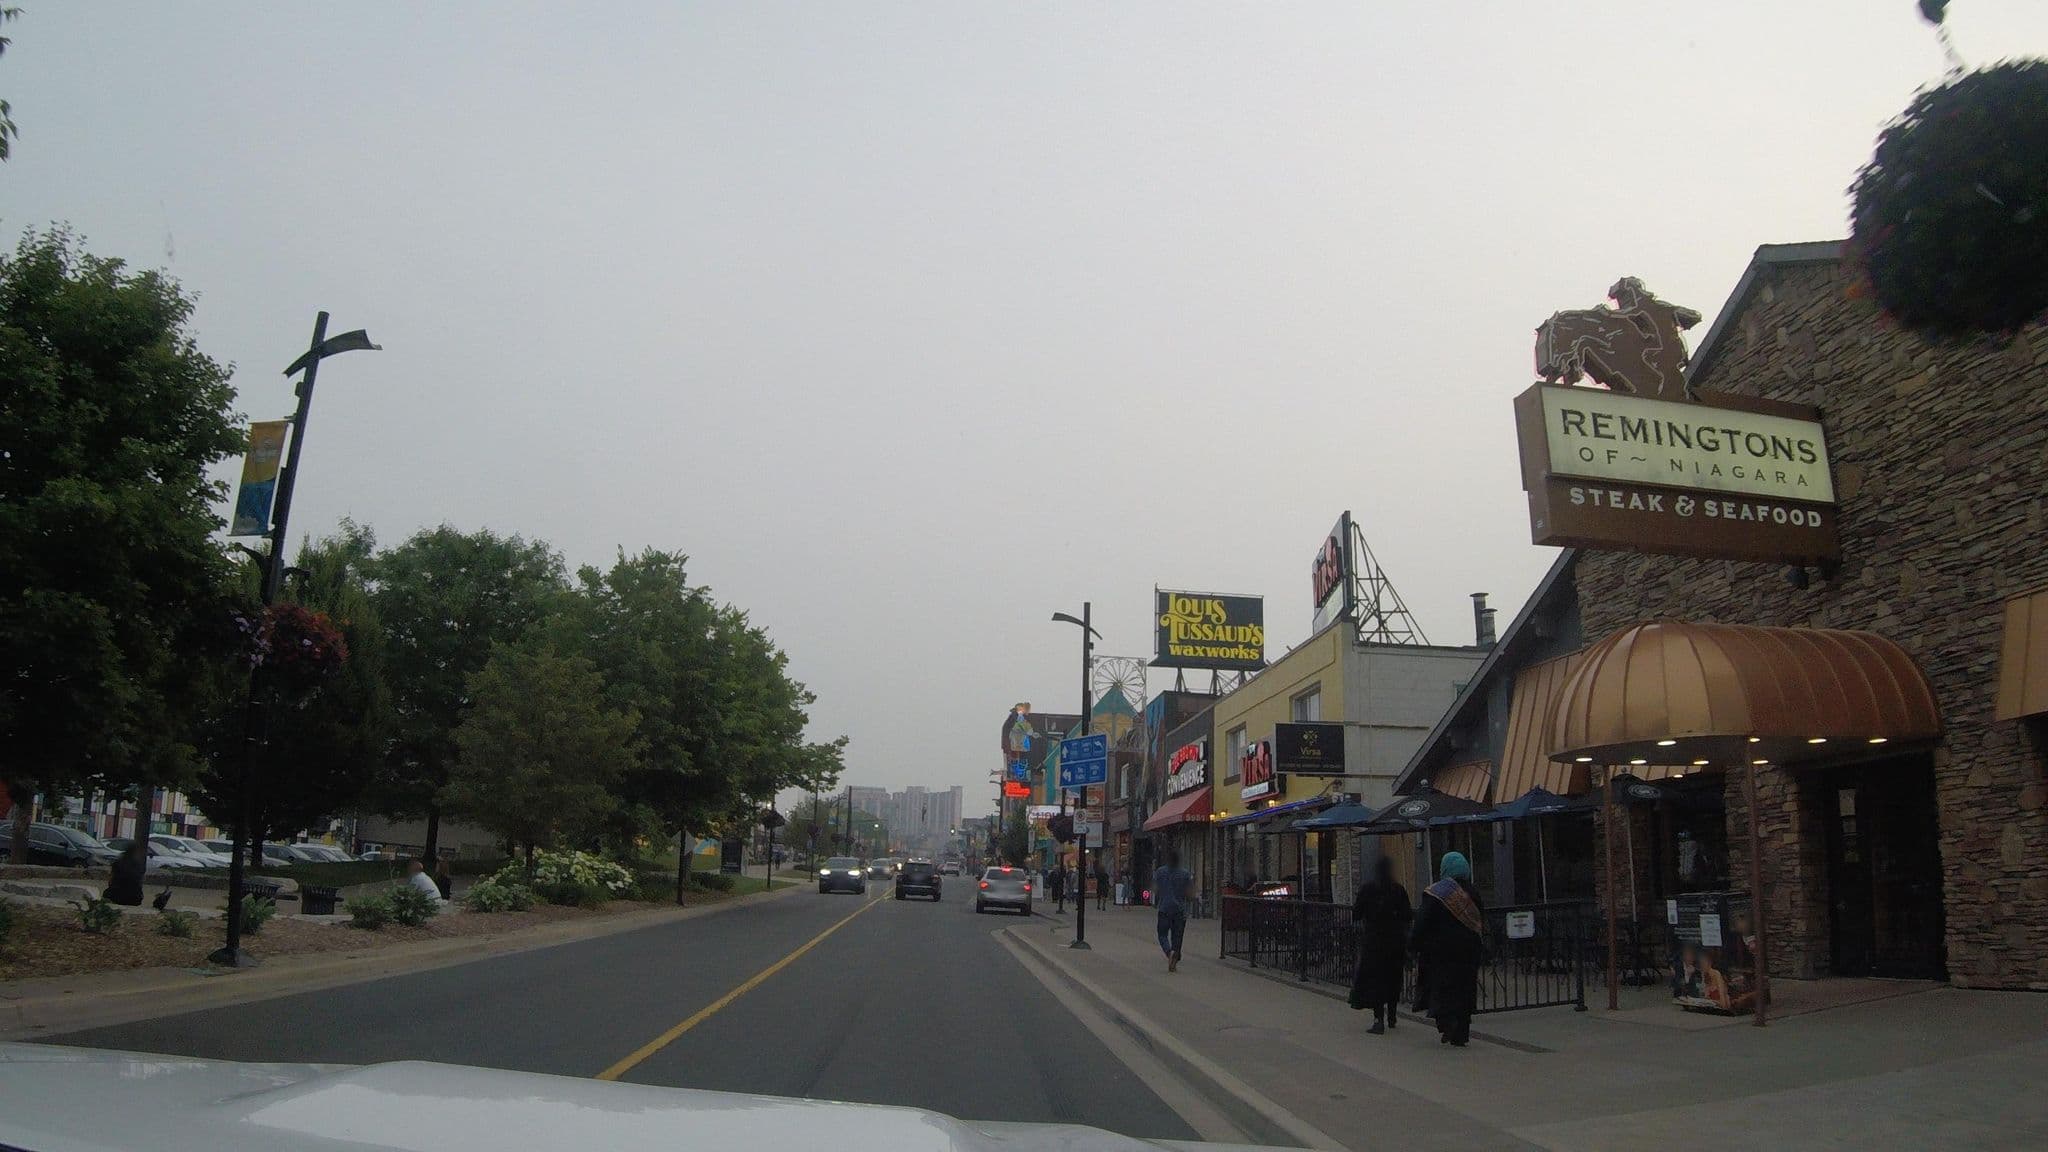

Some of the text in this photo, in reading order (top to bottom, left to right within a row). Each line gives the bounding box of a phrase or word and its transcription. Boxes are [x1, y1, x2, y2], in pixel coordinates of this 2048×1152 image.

[1560, 408, 1818, 465] REMINGTONS
[1578, 446, 1809, 487] OF NIAGARA
[1569, 487, 1823, 528] STEAK & SEAFOOD
[1160, 613, 1264, 647] TUSSAUD'S
